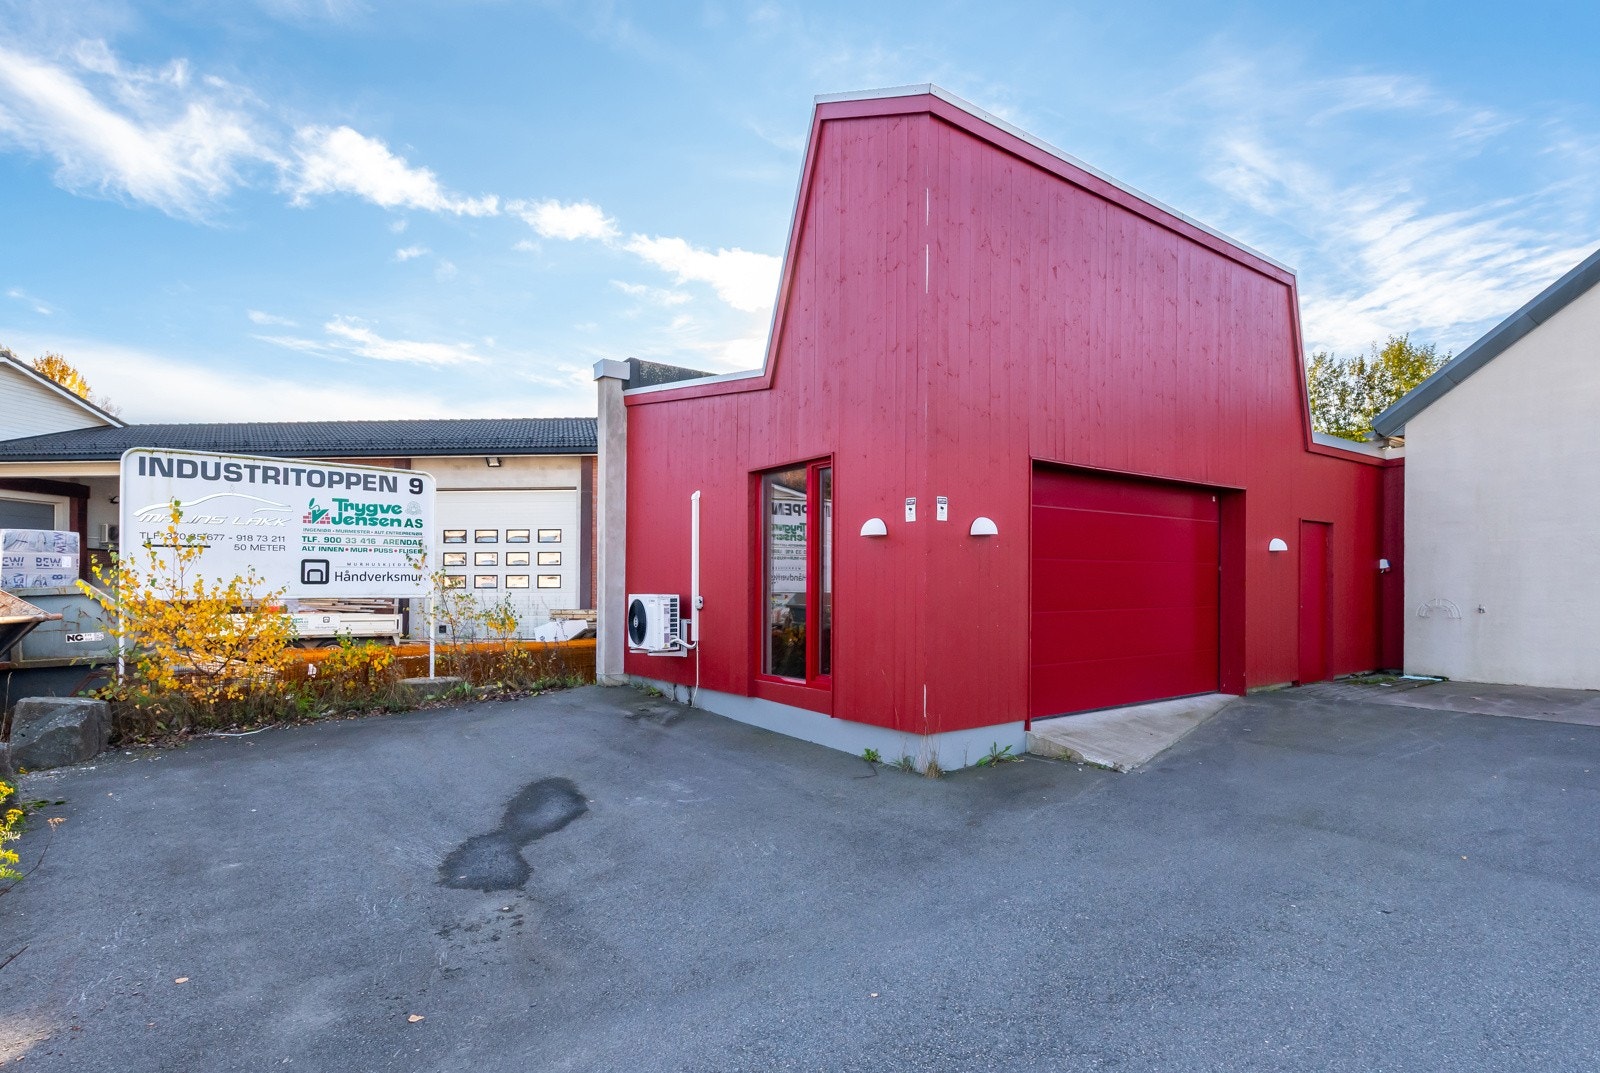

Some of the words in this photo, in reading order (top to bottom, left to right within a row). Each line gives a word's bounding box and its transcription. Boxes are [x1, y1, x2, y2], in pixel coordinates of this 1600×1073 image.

[138, 456, 398, 493] INDUSTRITOPPEN
[409, 478, 424, 495] 9
[332, 498, 402, 517] Trygve
[331, 512, 402, 527] Jensen
[404, 518, 424, 528] AS
[236, 534, 253, 542] 918
[301, 535, 320, 543] TLF.
[250, 544, 286, 552] METER
[35, 557, 62, 567] BEW
[334, 570, 422, 582] Håndverksmur
